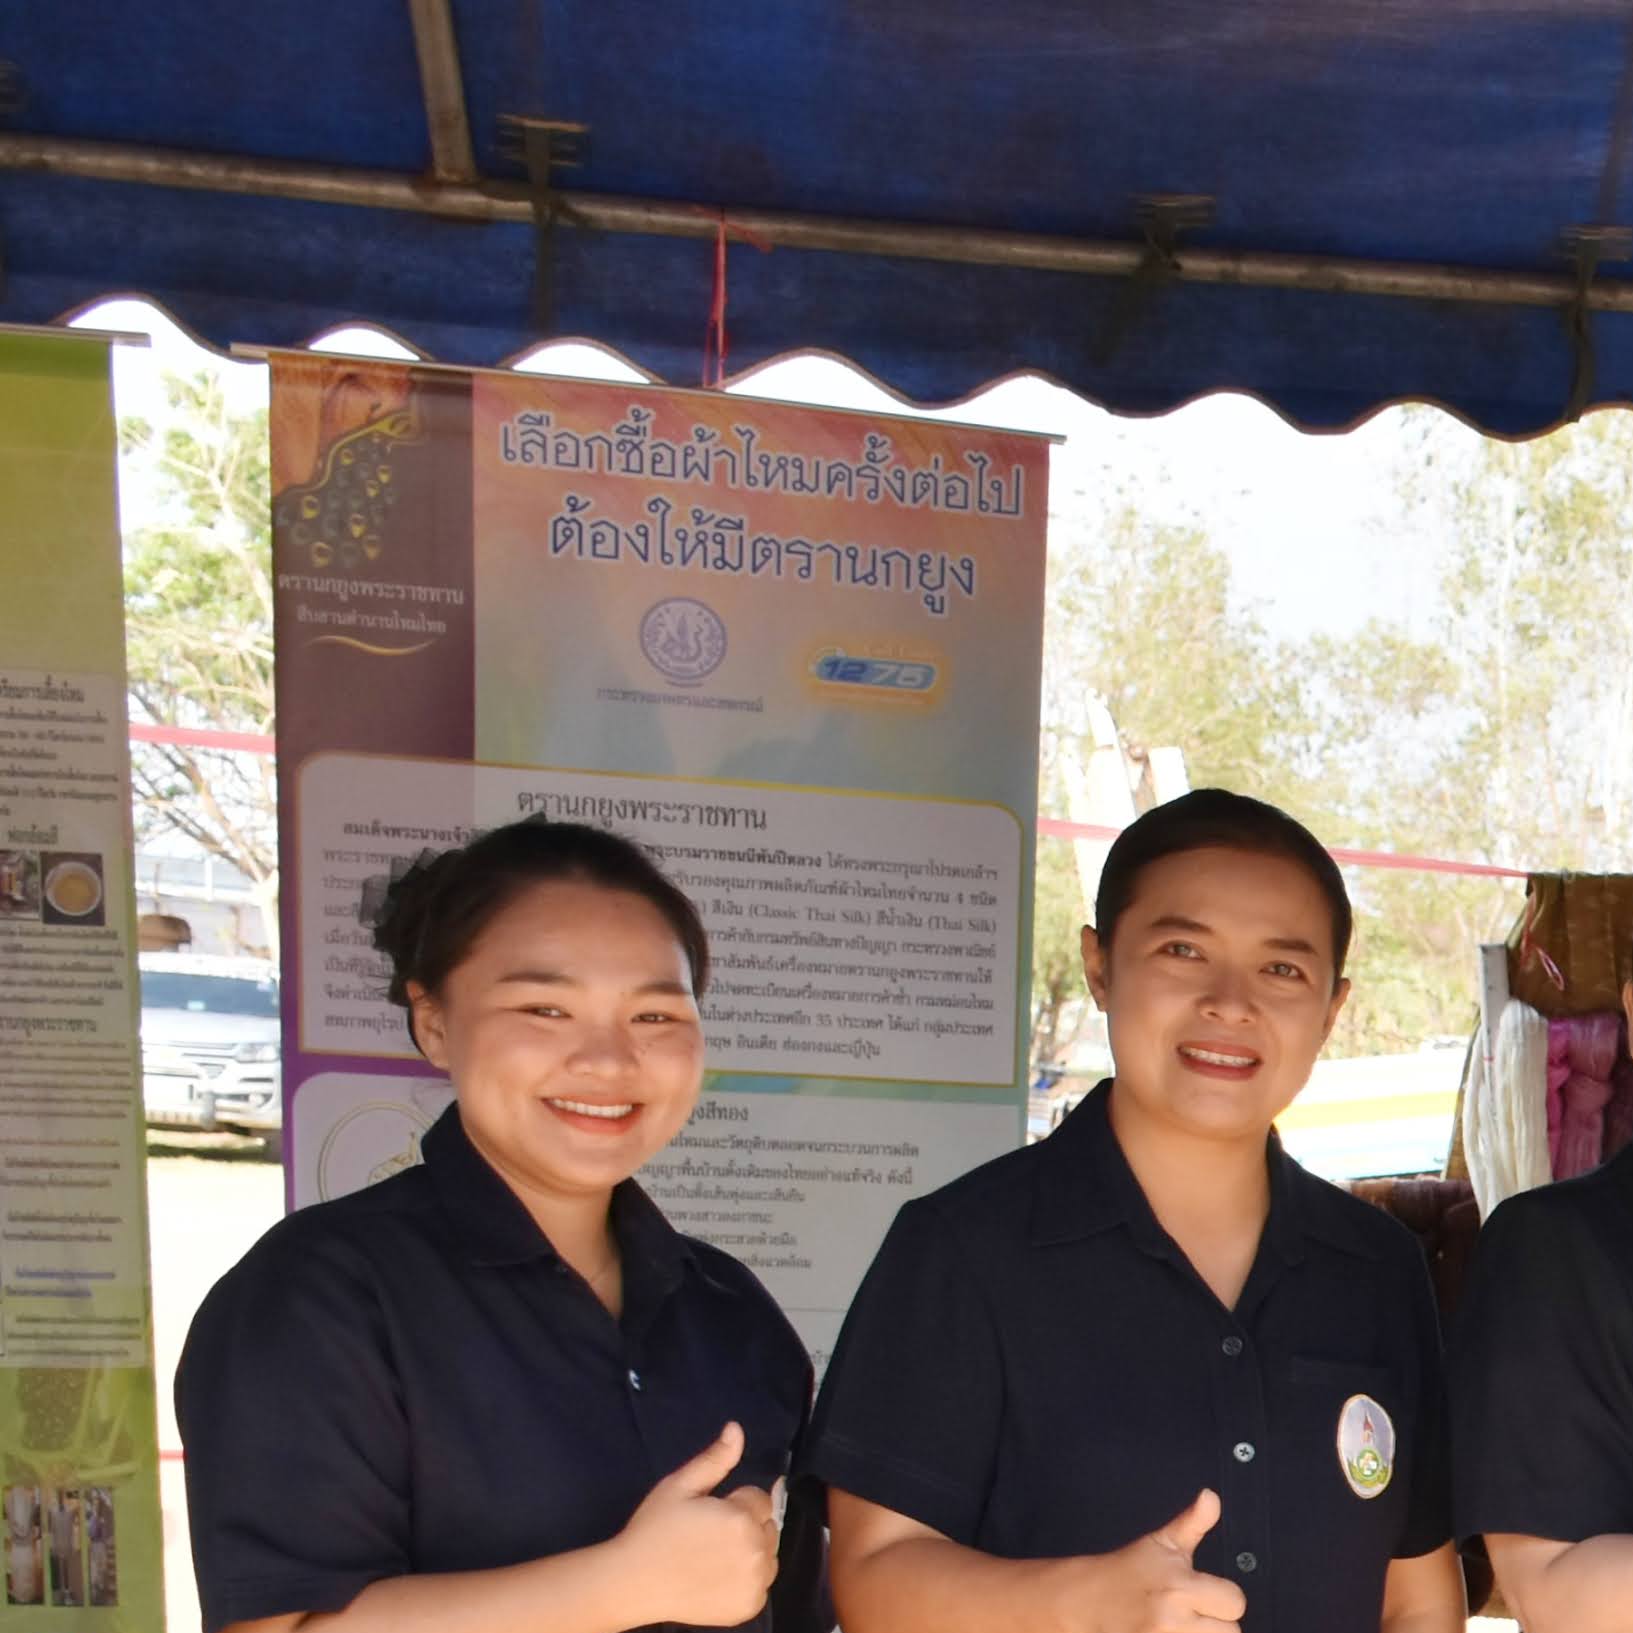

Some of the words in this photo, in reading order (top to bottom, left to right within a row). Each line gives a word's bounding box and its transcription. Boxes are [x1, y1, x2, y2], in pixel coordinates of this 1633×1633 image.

[500, 407, 1022, 519] เลือกซื้อผ้าไหมครั้งต่อไป
[548, 493, 977, 616] ต้องให้มีตรานกยูง
[279, 574, 464, 605] ตรานกยูงพระราชทาน
[343, 820, 478, 842] สมเด็จพระนางเจ้า
[518, 790, 768, 831] ตรานกยูงพระราชทาน
